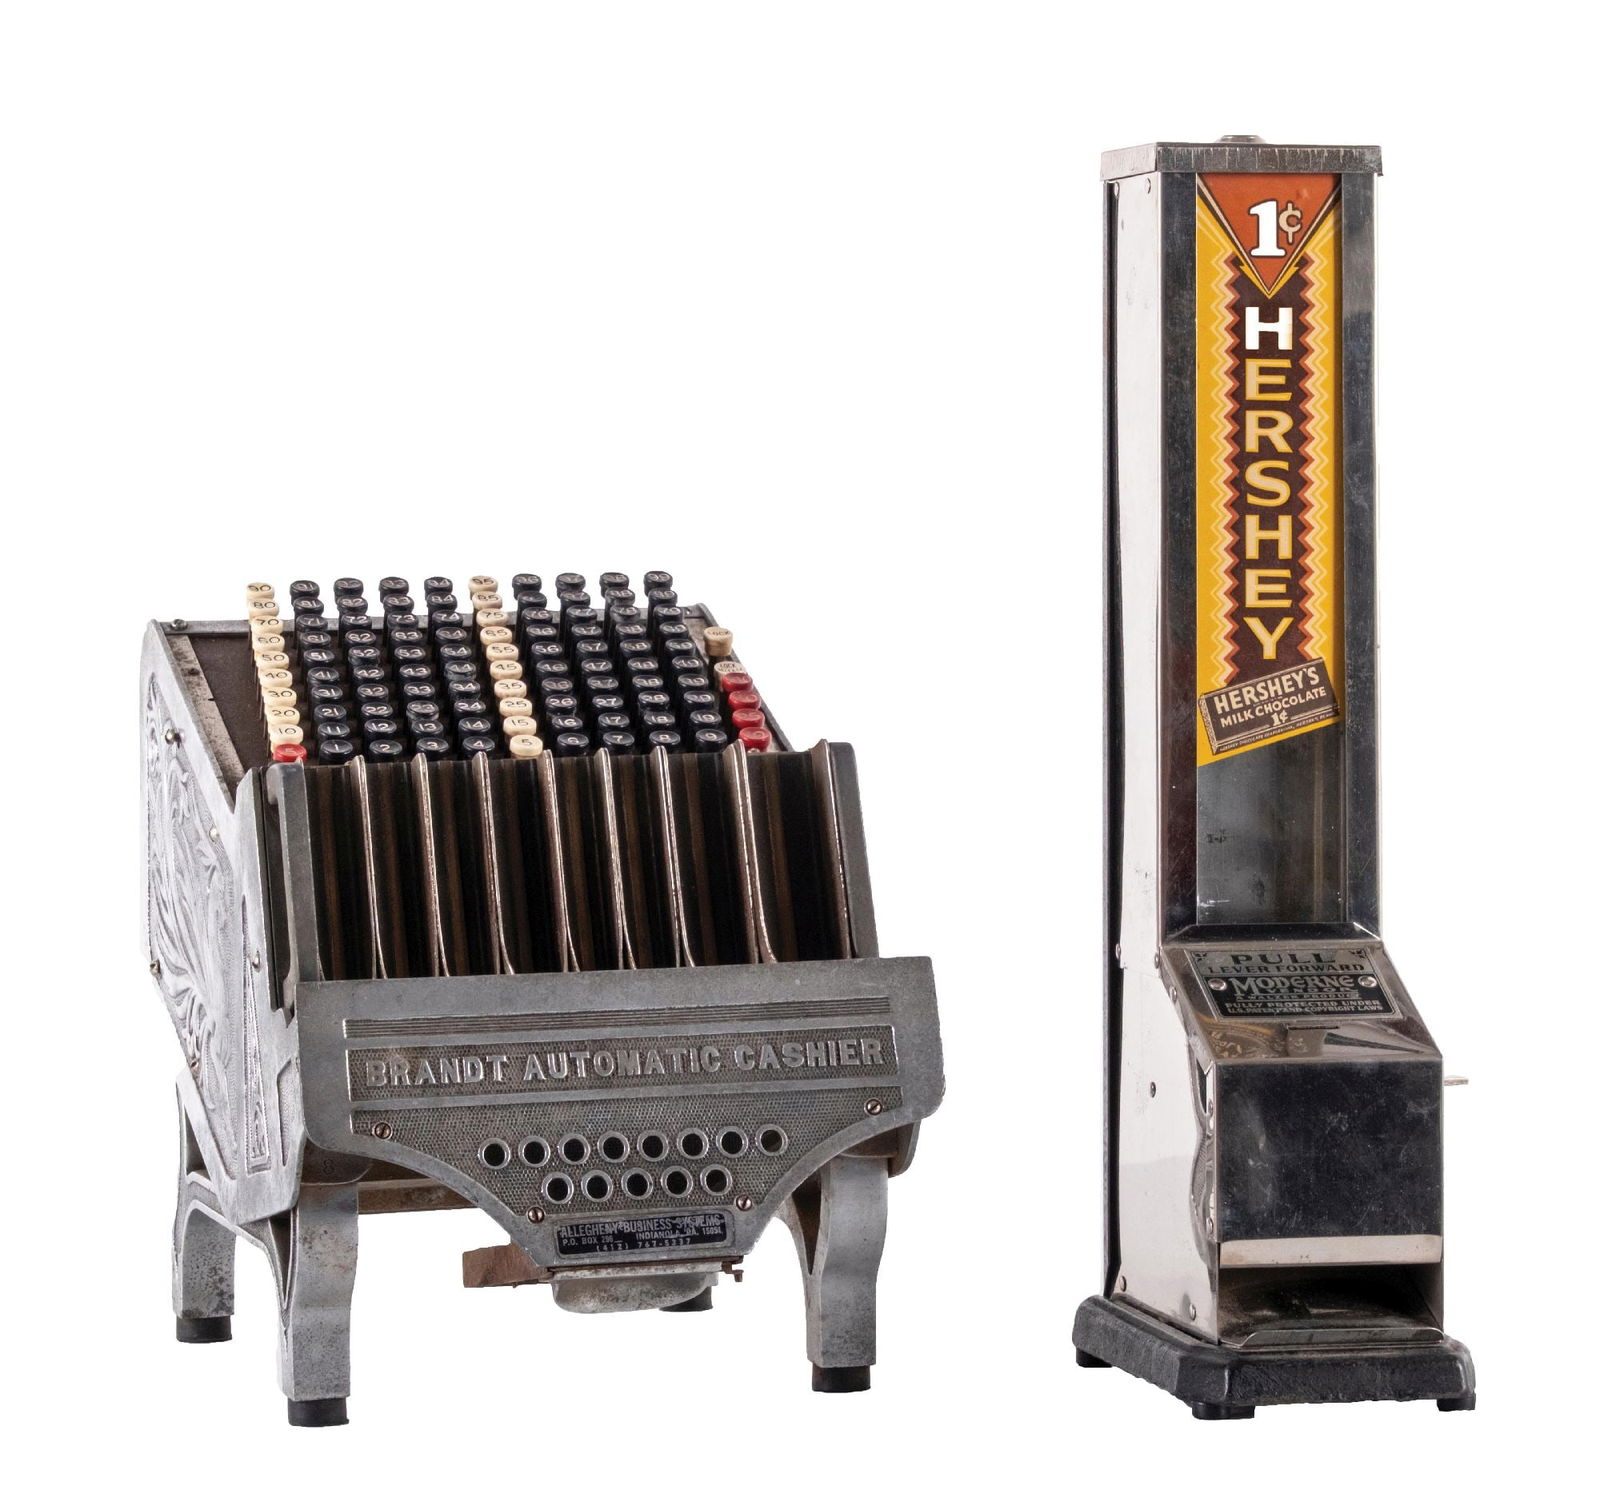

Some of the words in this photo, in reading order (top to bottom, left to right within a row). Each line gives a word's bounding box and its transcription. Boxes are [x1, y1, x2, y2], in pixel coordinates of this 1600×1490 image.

[1248, 200, 1302, 257] 1¢
[1243, 307, 1294, 660] HERSHEY
[254, 601, 276, 609] 80
[346, 615, 368, 623] 72
[391, 614, 415, 623] 73
[436, 612, 460, 620] 74
[303, 617, 320, 625] 71
[307, 634, 324, 643] 61
[348, 633, 371, 642] 62
[395, 631, 419, 640] 63
[352, 648, 376, 657] 52
[399, 648, 423, 657] 53
[444, 646, 468, 655] 54
[535, 644, 559, 653] 56
[310, 652, 328, 660] 51
[450, 663, 473, 671] 44
[543, 663, 565, 671] 46
[585, 661, 607, 670] 47
[265, 671, 288, 679] 40
[357, 669, 379, 677] 42
[403, 667, 427, 675] 43
[408, 685, 431, 694] 33
[452, 682, 476, 691] 34
[498, 682, 523, 690] 35
[1214, 666, 1320, 714] HERSHEY'S
[319, 688, 336, 696] 31
[361, 687, 383, 695] 32
[457, 701, 482, 710] 24
[504, 700, 527, 708] 25
[549, 698, 574, 706] 26
[595, 697, 617, 706] 27
[321, 707, 339, 716] 21
[365, 705, 387, 713] 22
[1220, 708, 1255, 728] MILK
[1255, 686, 1327, 717] CHOCOLATE
[558, 718, 577, 726] 16
[605, 716, 622, 724] 17
[651, 715, 668, 724] 18
[696, 713, 715, 722] 19
[1271, 709, 1289, 727] 1¢
[371, 722, 389, 731] 12
[419, 723, 437, 731] 13
[465, 720, 484, 729] 14
[511, 719, 529, 727] 15
[278, 727, 296, 735] 10
[326, 725, 341, 734] 11
[611, 735, 623, 743] 7
[659, 734, 670, 742] 8
[704, 732, 718, 740] 9
[426, 741, 439, 749] 3
[472, 740, 484, 748] 4
[521, 738, 533, 746] 5
[334, 743, 340, 751] 1
[379, 743, 390, 752] 2
[1230, 953, 1336, 965] PULL
[1208, 965, 1271, 974] LEVER
[1280, 963, 1366, 973] FORWARD
[366, 1053, 507, 1087] BRANDT
[523, 1045, 721, 1081] AUTOMATIC
[734, 1038, 883, 1071] CASHIER
[560, 1222, 618, 1238] ALLEGHENY
[623, 1217, 673, 1233] BUSINESS
[581, 1236, 598, 1245] BOX
